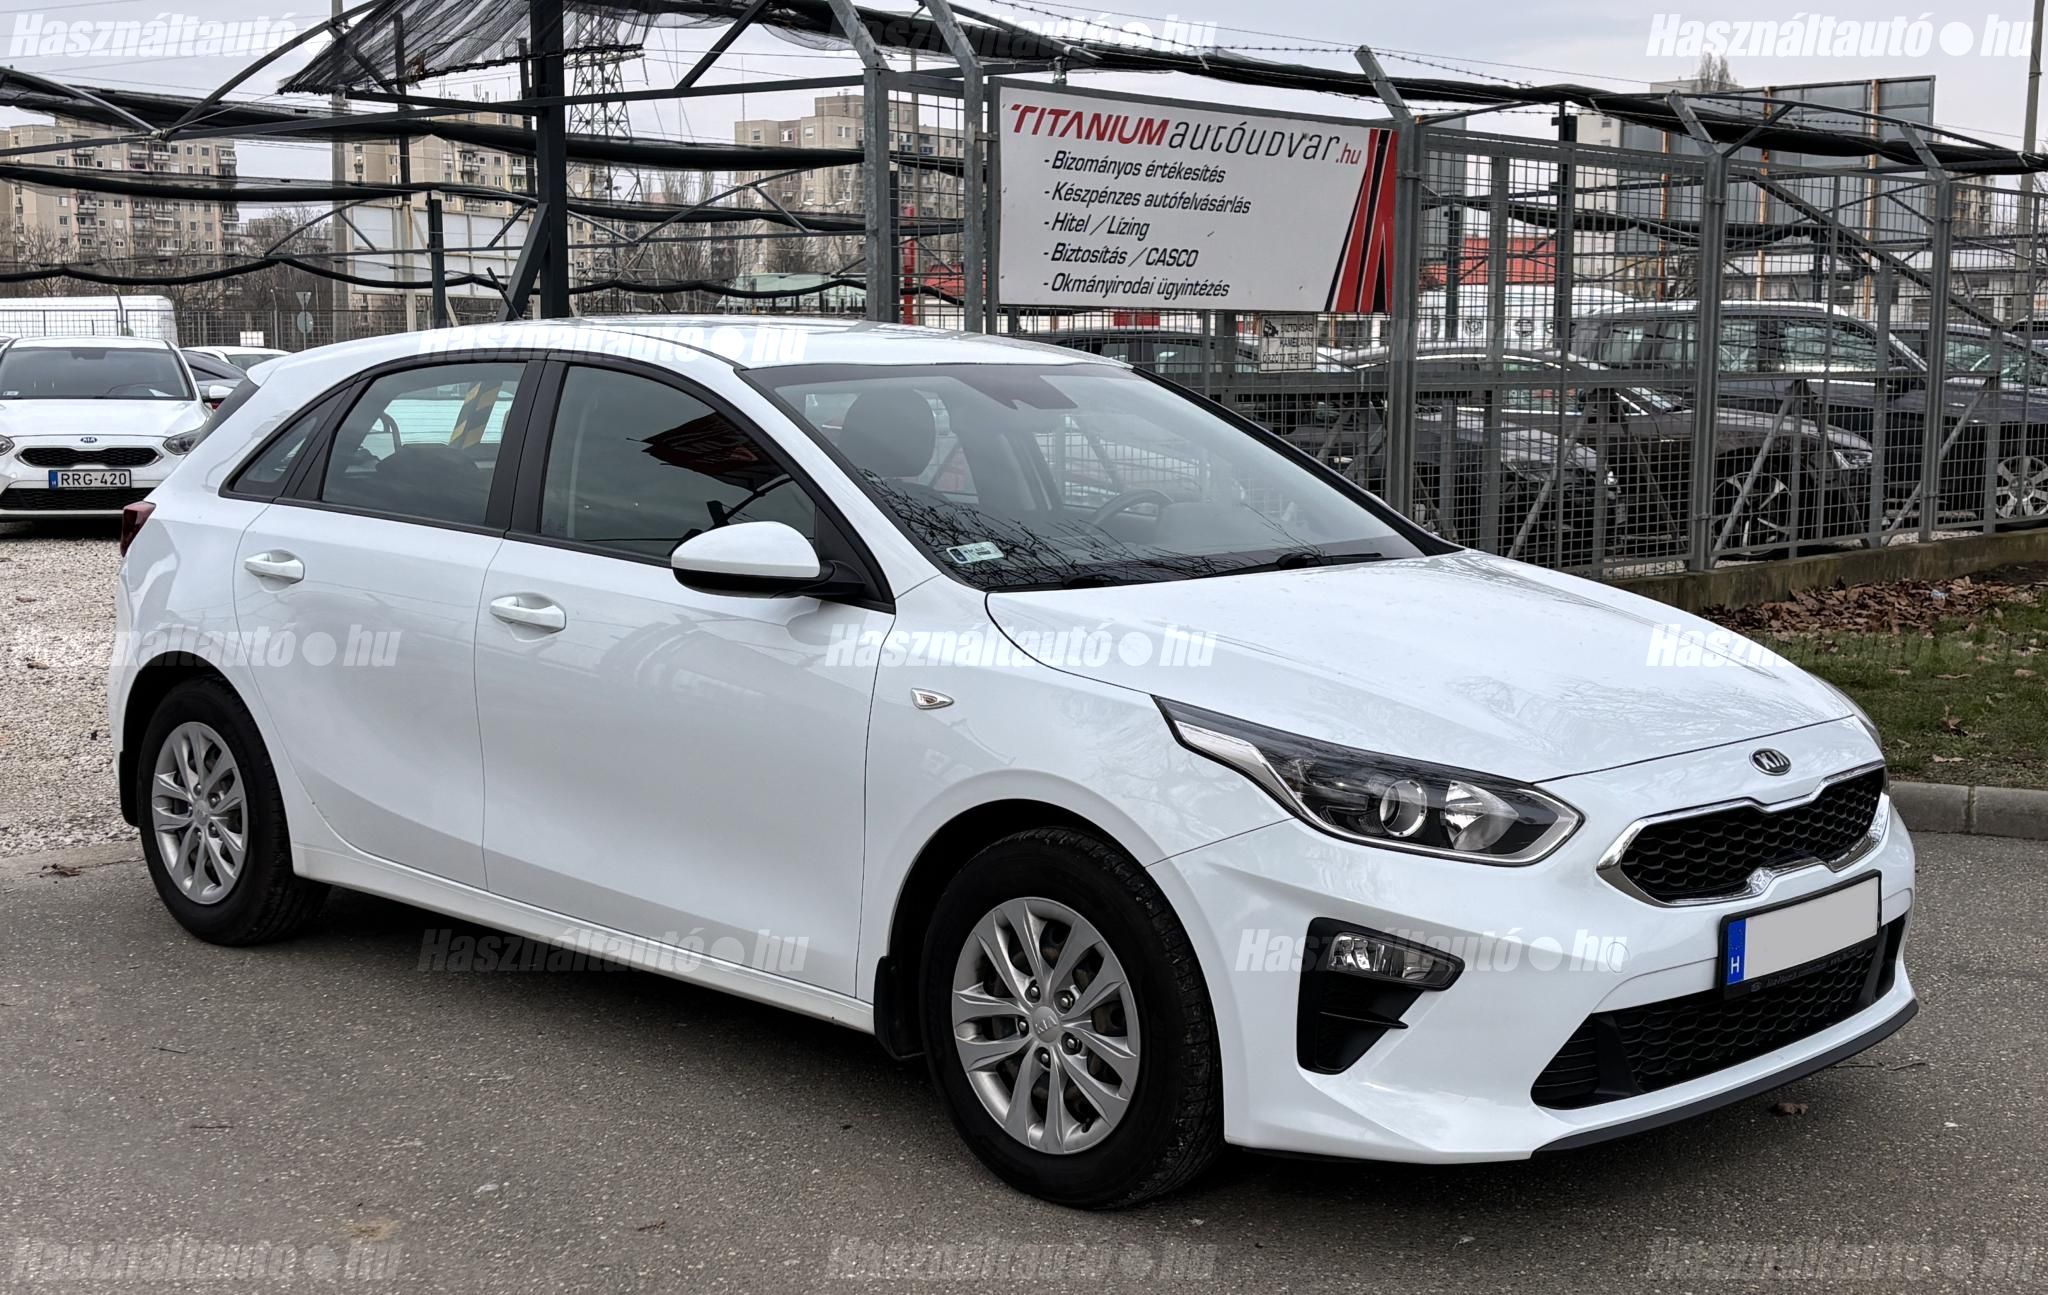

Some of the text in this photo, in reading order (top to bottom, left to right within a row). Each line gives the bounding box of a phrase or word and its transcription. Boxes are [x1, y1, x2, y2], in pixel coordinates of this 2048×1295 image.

[1011, 103, 1170, 146] TITANIUM
[1052, 150, 1142, 180] Bizományos
[1145, 160, 1226, 183] értékesítés
[1052, 181, 1142, 208] Készpénzes
[1144, 191, 1251, 214] autófelvásárlás
[1051, 272, 1157, 298] Okmányirodai
[1157, 278, 1230, 300] ügyintézés
[61, 473, 127, 485] RRG-420
[1754, 750, 1790, 770] KIA
[1730, 955, 1740, 975] H
